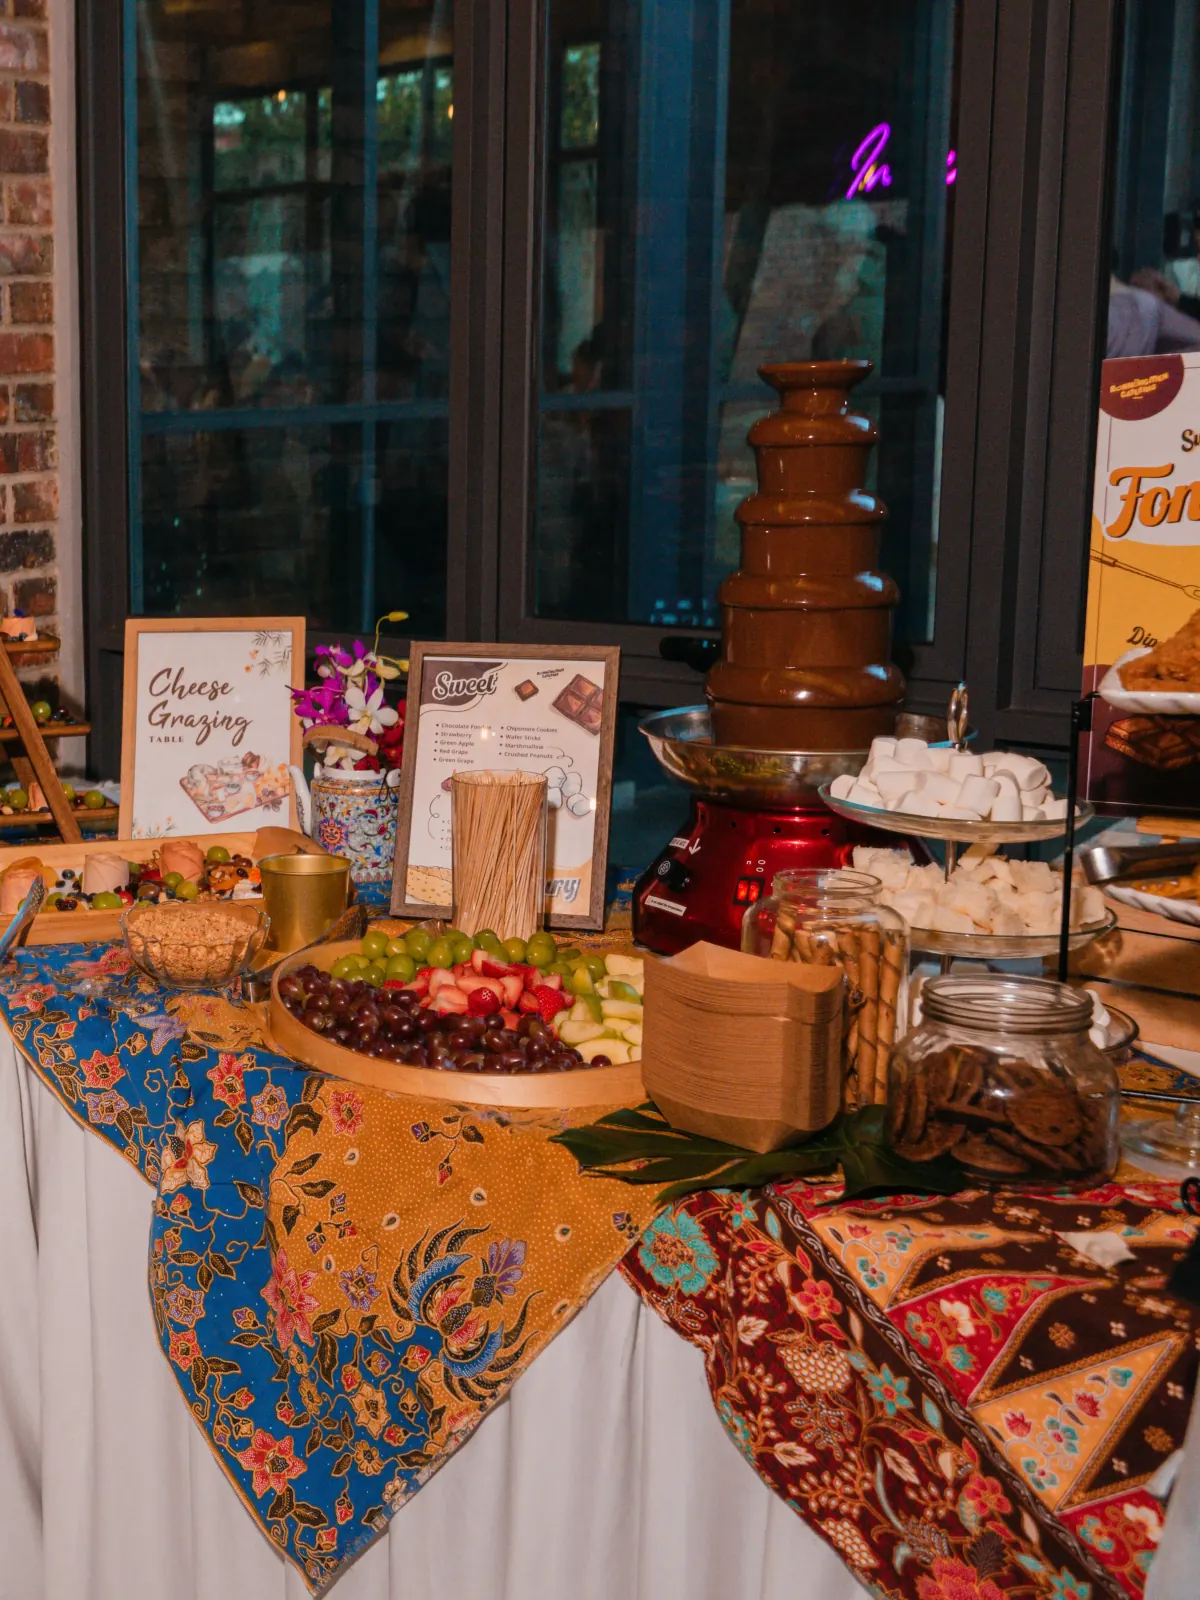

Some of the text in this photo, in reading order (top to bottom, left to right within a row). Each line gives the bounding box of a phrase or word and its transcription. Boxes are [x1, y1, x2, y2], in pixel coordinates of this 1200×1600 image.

[149, 667, 234, 701] Cheese
[433, 671, 498, 700] Sweet
[148, 699, 253, 747] Grazing
[149, 735, 184, 743] TABLE
